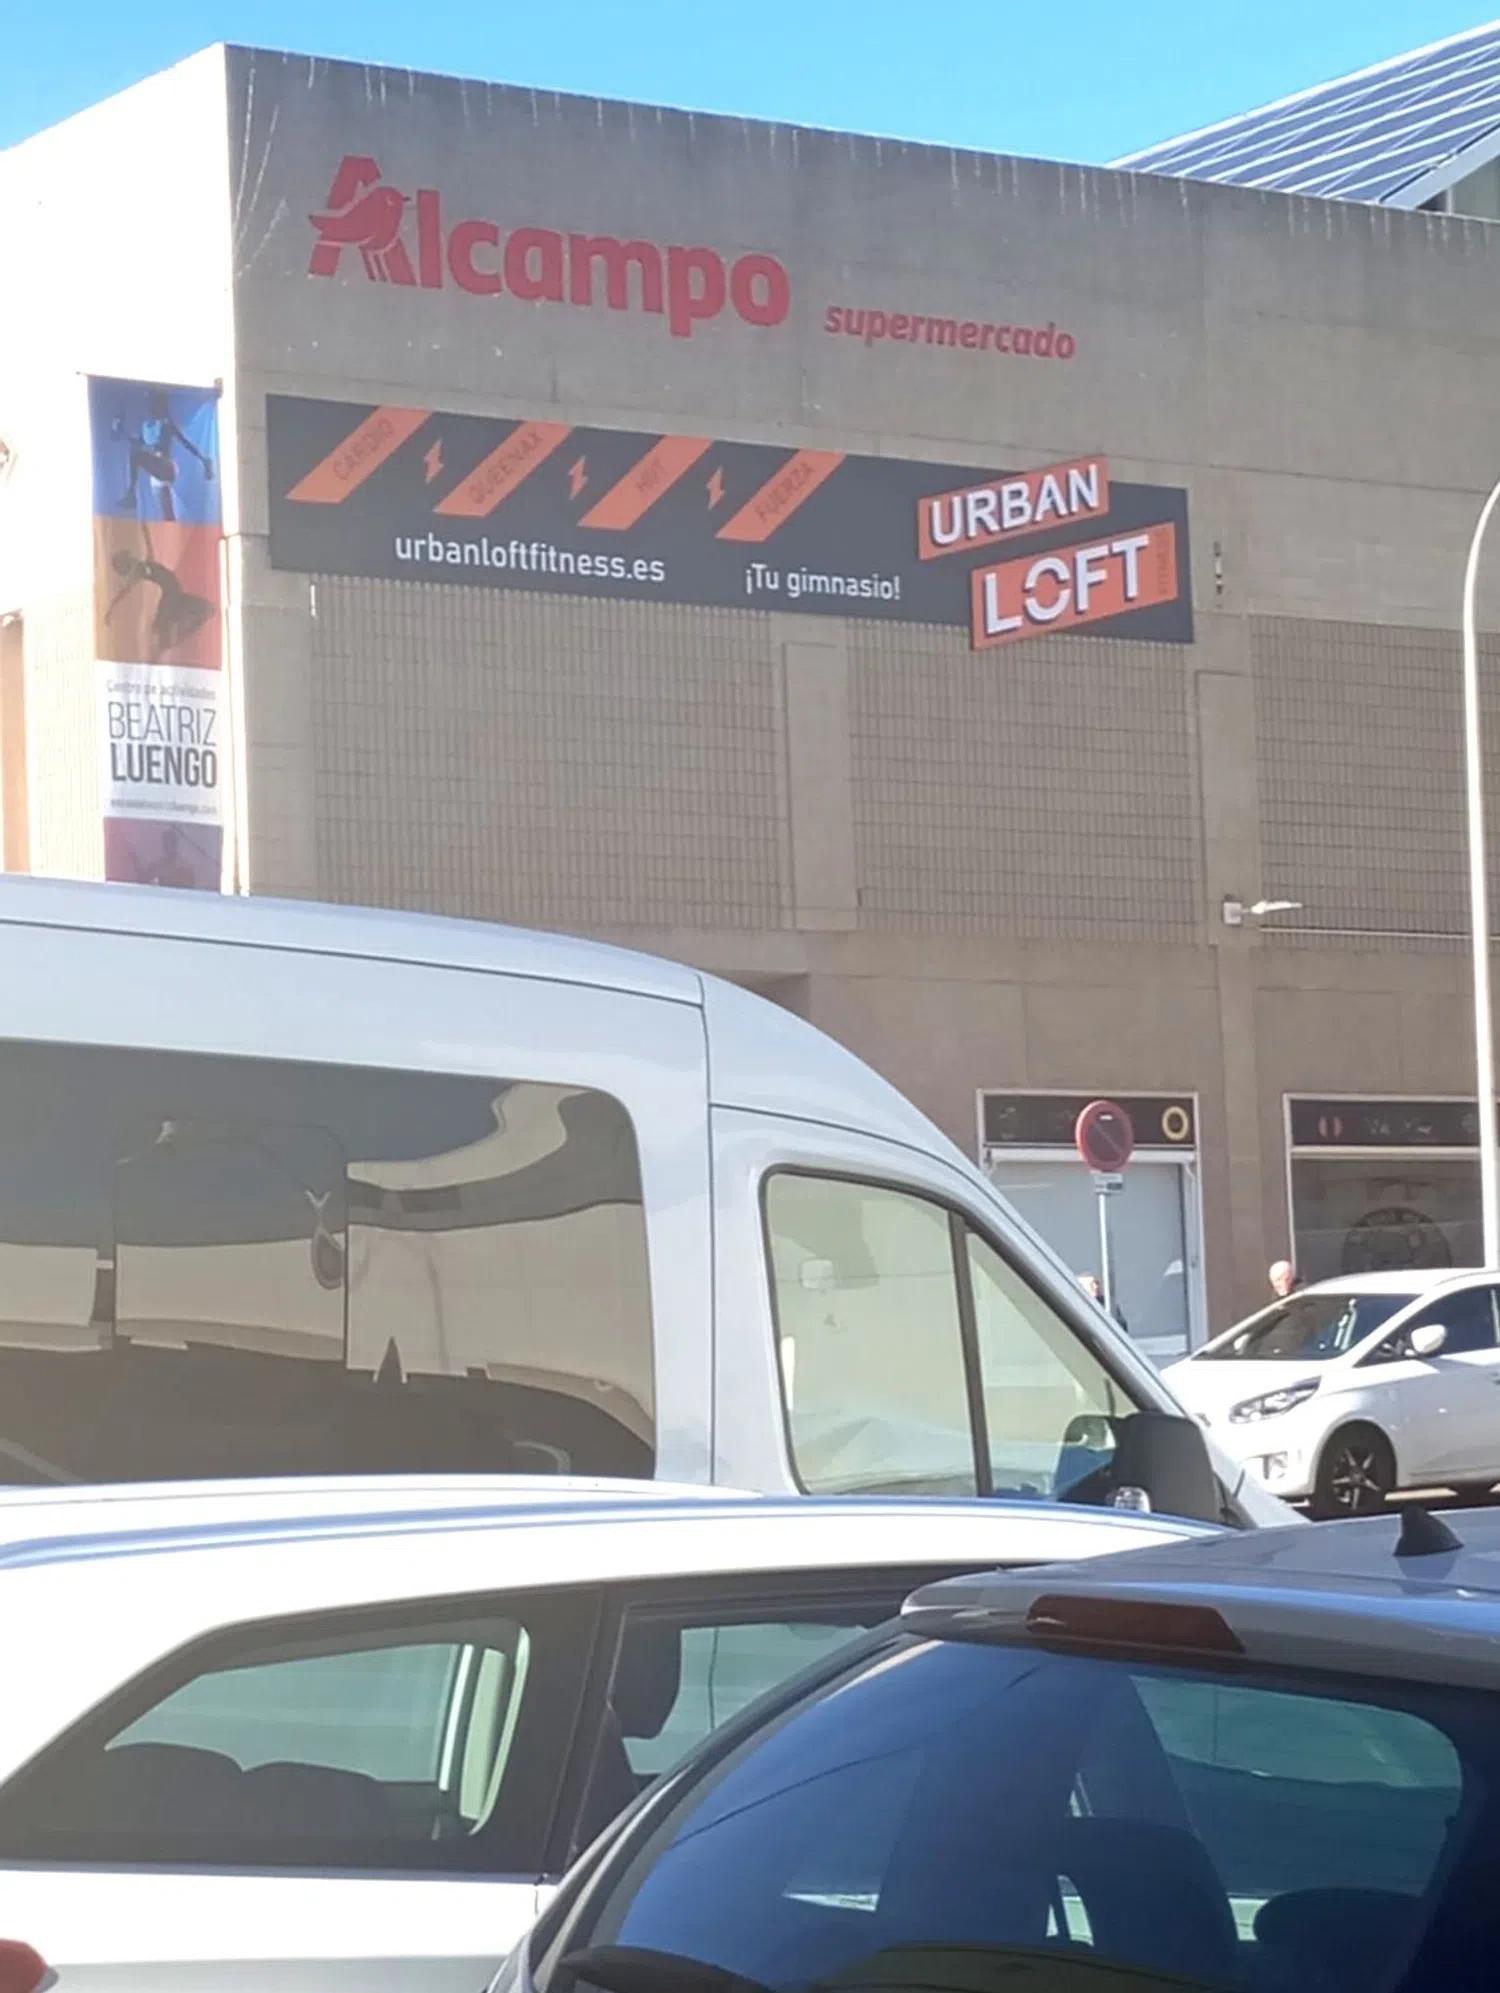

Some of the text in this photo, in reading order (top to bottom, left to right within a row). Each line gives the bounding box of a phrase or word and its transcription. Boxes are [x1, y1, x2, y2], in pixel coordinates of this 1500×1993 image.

[308, 155, 791, 338] Alcampo
[824, 305, 1076, 359] supermercado
[930, 463, 1100, 546] URBAN
[395, 532, 667, 582] urbanloftfitness.es
[746, 563, 901, 600] ¡Tu gimnasio!
[983, 533, 1150, 637] LOFT
[108, 701, 217, 747] BEATRIZ
[110, 742, 218, 789] LUENGO
